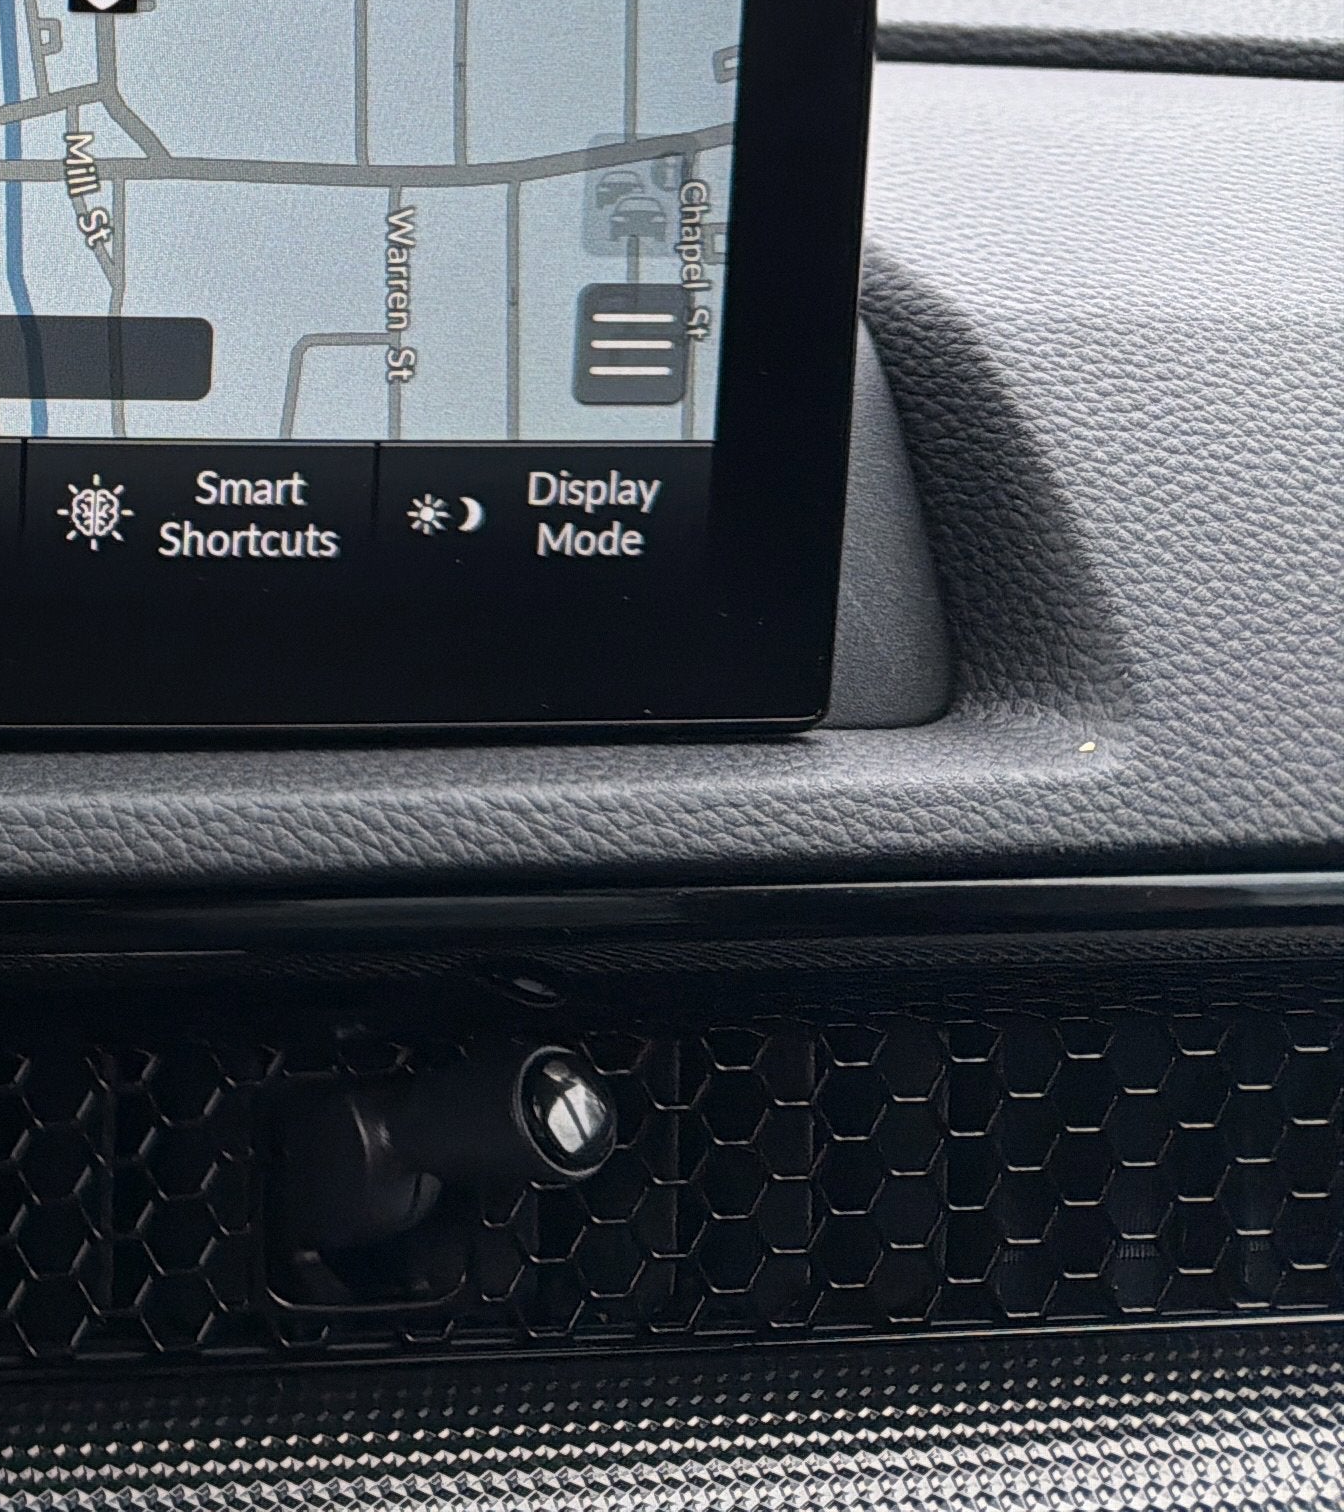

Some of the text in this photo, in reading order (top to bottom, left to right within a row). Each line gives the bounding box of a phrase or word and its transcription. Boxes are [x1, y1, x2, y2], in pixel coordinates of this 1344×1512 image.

[65, 133, 112, 248] Mill St
[675, 180, 711, 338] Chapel St
[387, 208, 417, 381] Warren St
[195, 469, 308, 509] Smart
[527, 469, 661, 515] Display
[158, 521, 340, 560] Shortcuts
[537, 521, 646, 558] Mode
